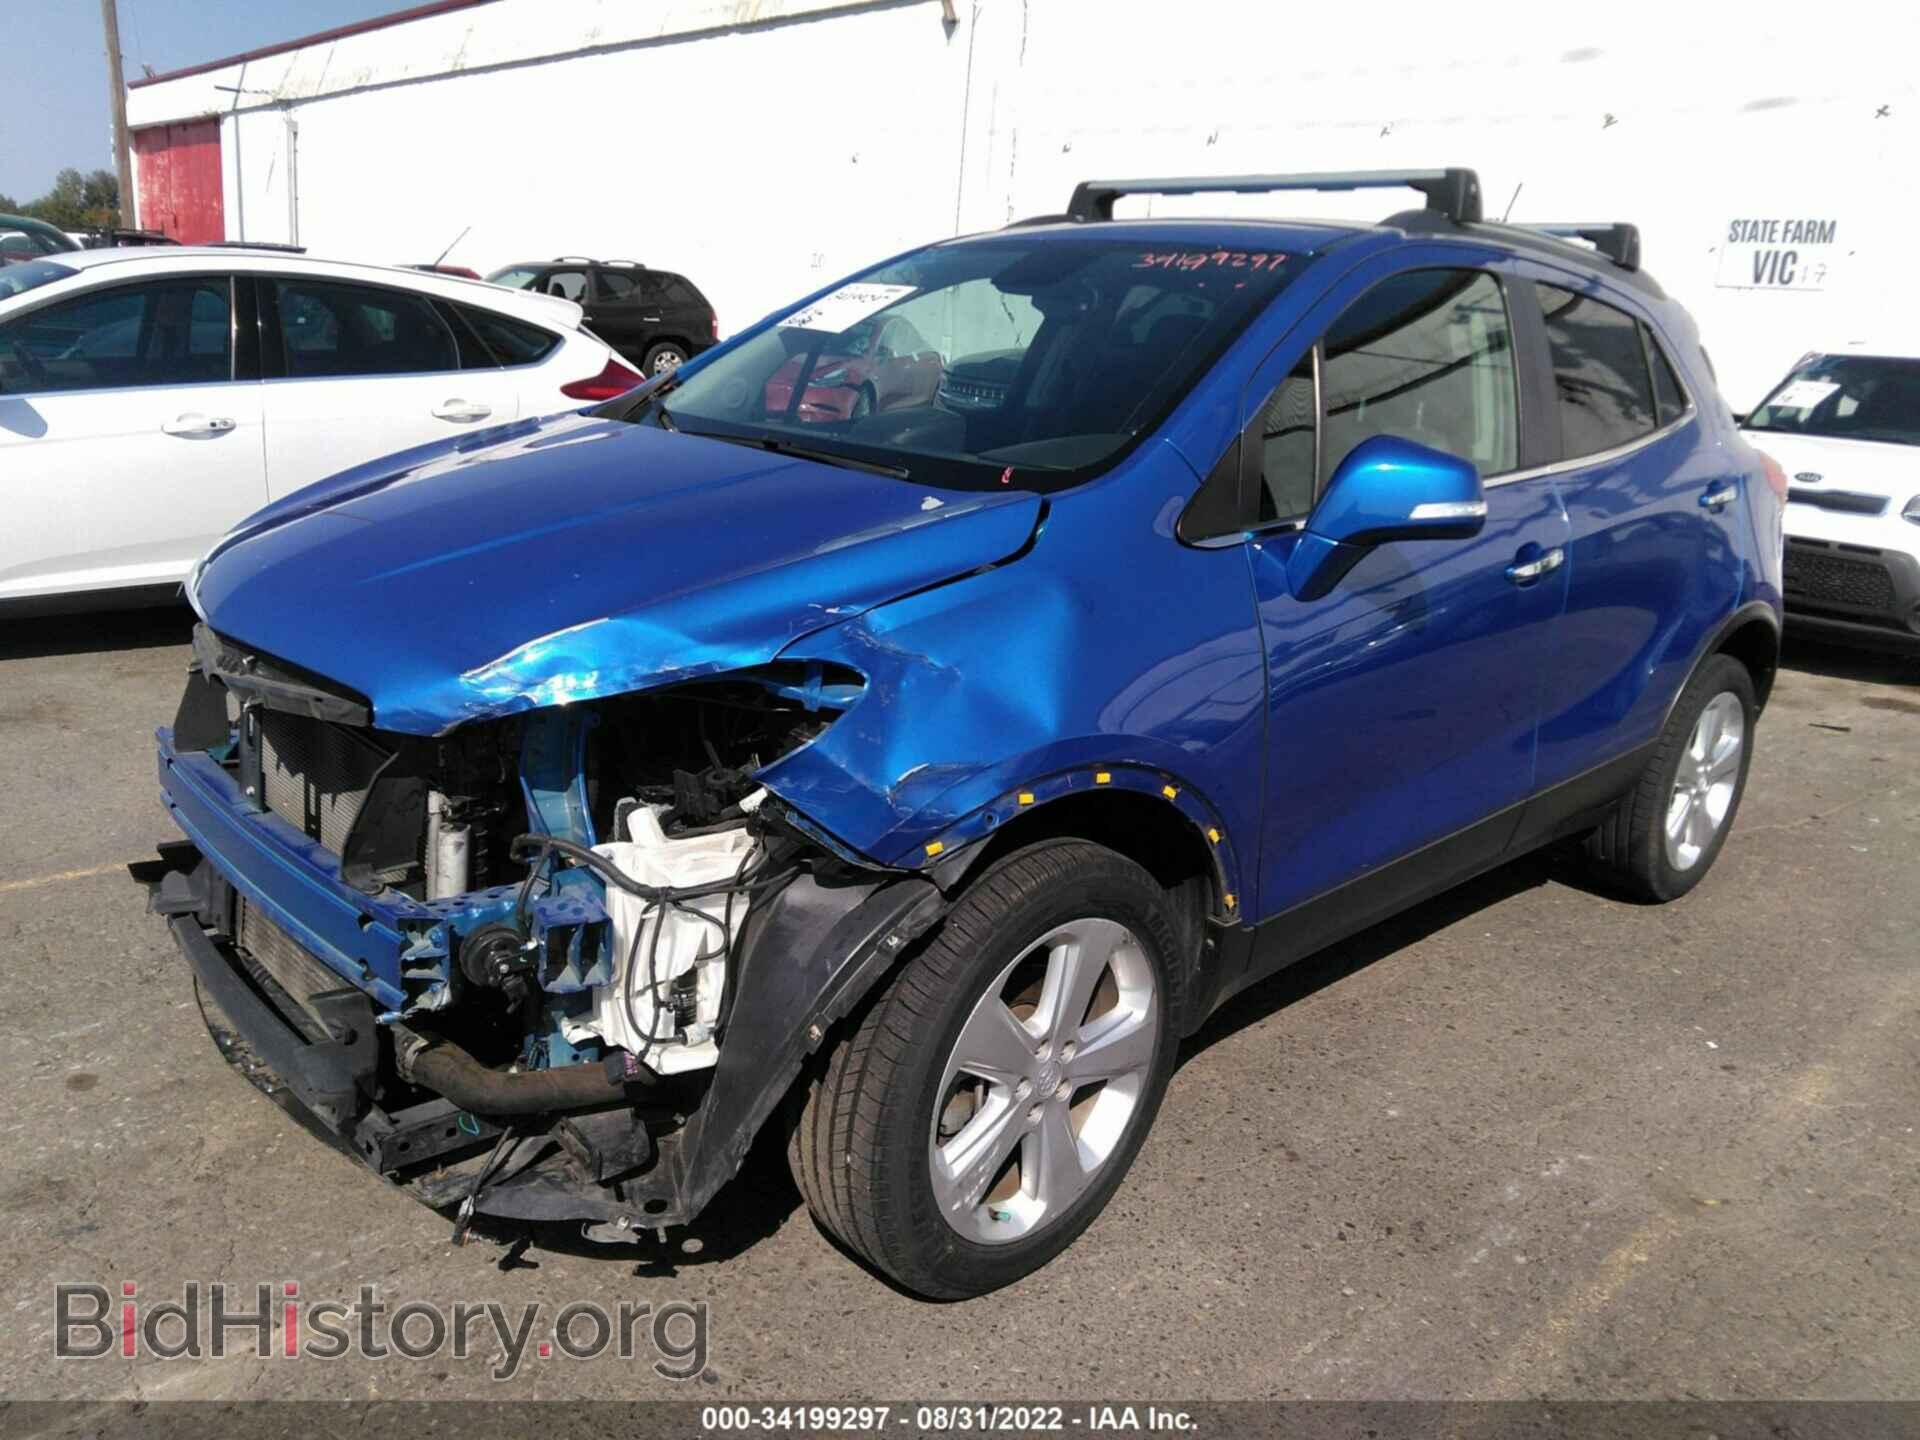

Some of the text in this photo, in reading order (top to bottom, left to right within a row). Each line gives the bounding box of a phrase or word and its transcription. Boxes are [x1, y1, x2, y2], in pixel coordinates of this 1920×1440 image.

[1728, 219, 1837, 244] STATE FARM
[1753, 250, 1798, 285] VIC
